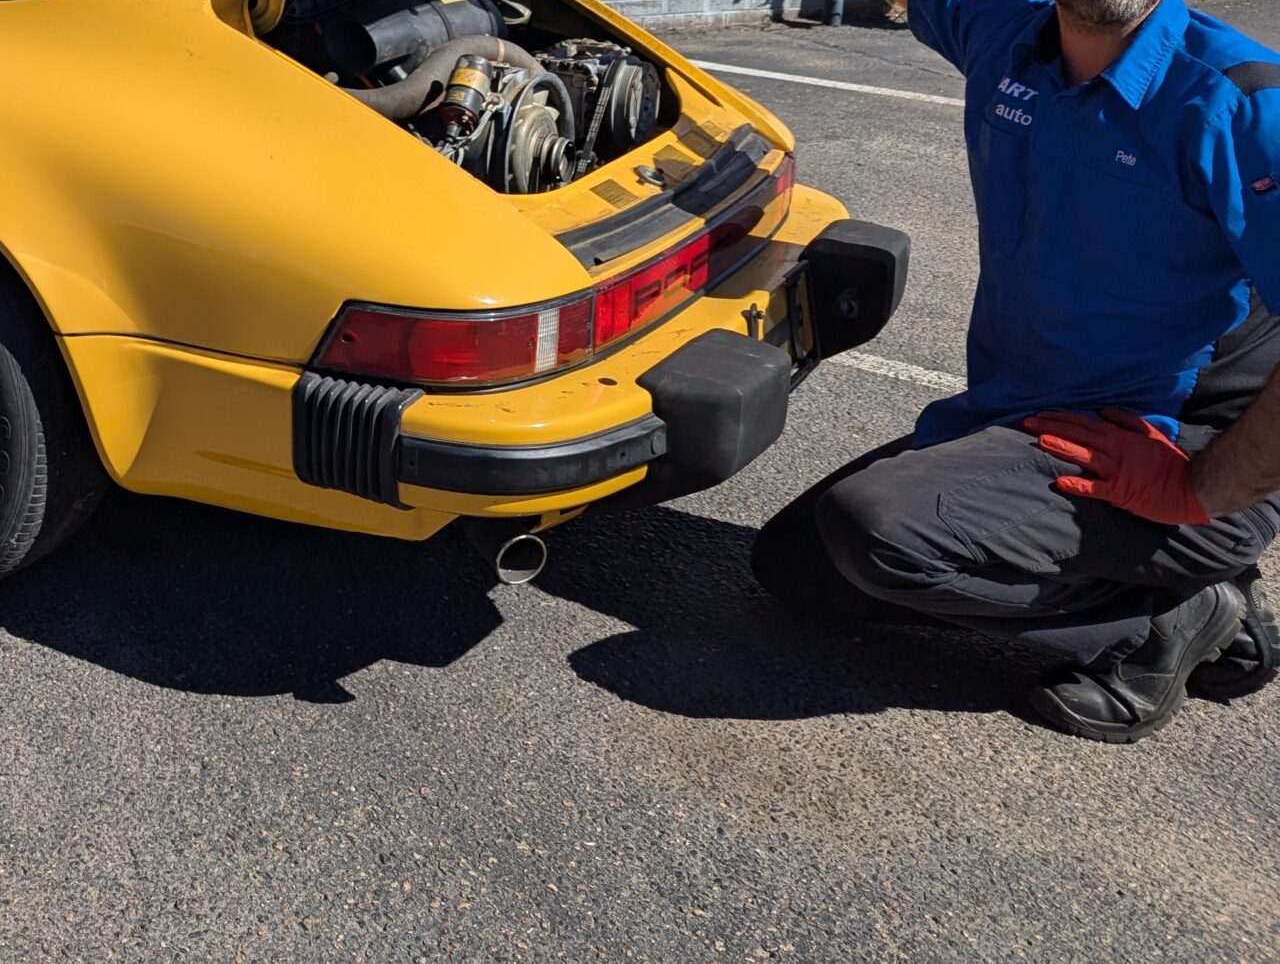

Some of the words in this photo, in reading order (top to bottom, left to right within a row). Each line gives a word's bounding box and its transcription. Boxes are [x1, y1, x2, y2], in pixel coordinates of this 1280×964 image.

[997, 76, 1039, 100] ART
[995, 103, 1033, 126] auto
[1114, 150, 1137, 166] Pete
